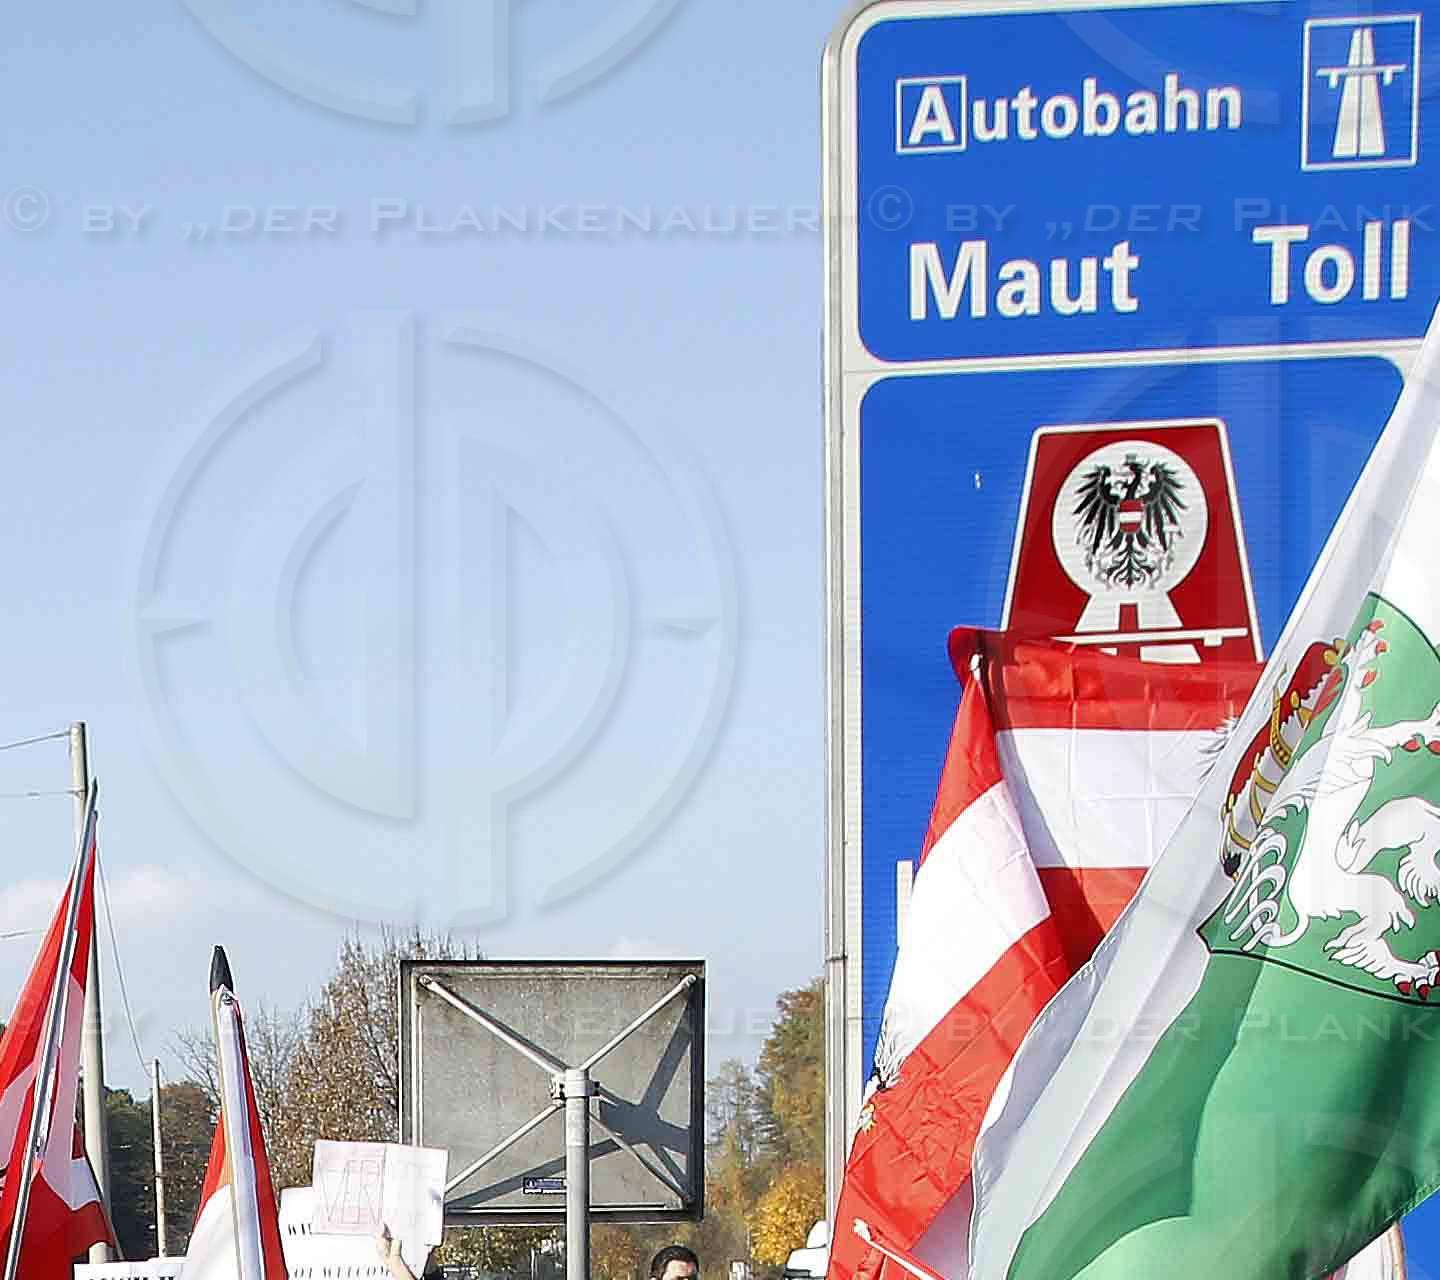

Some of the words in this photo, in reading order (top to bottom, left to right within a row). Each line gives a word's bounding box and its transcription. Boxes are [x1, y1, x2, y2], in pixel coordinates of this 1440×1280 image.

[909, 72, 1242, 148] Autobahn
[908, 240, 1139, 320] Maut
[1252, 221, 1411, 306] Toll
